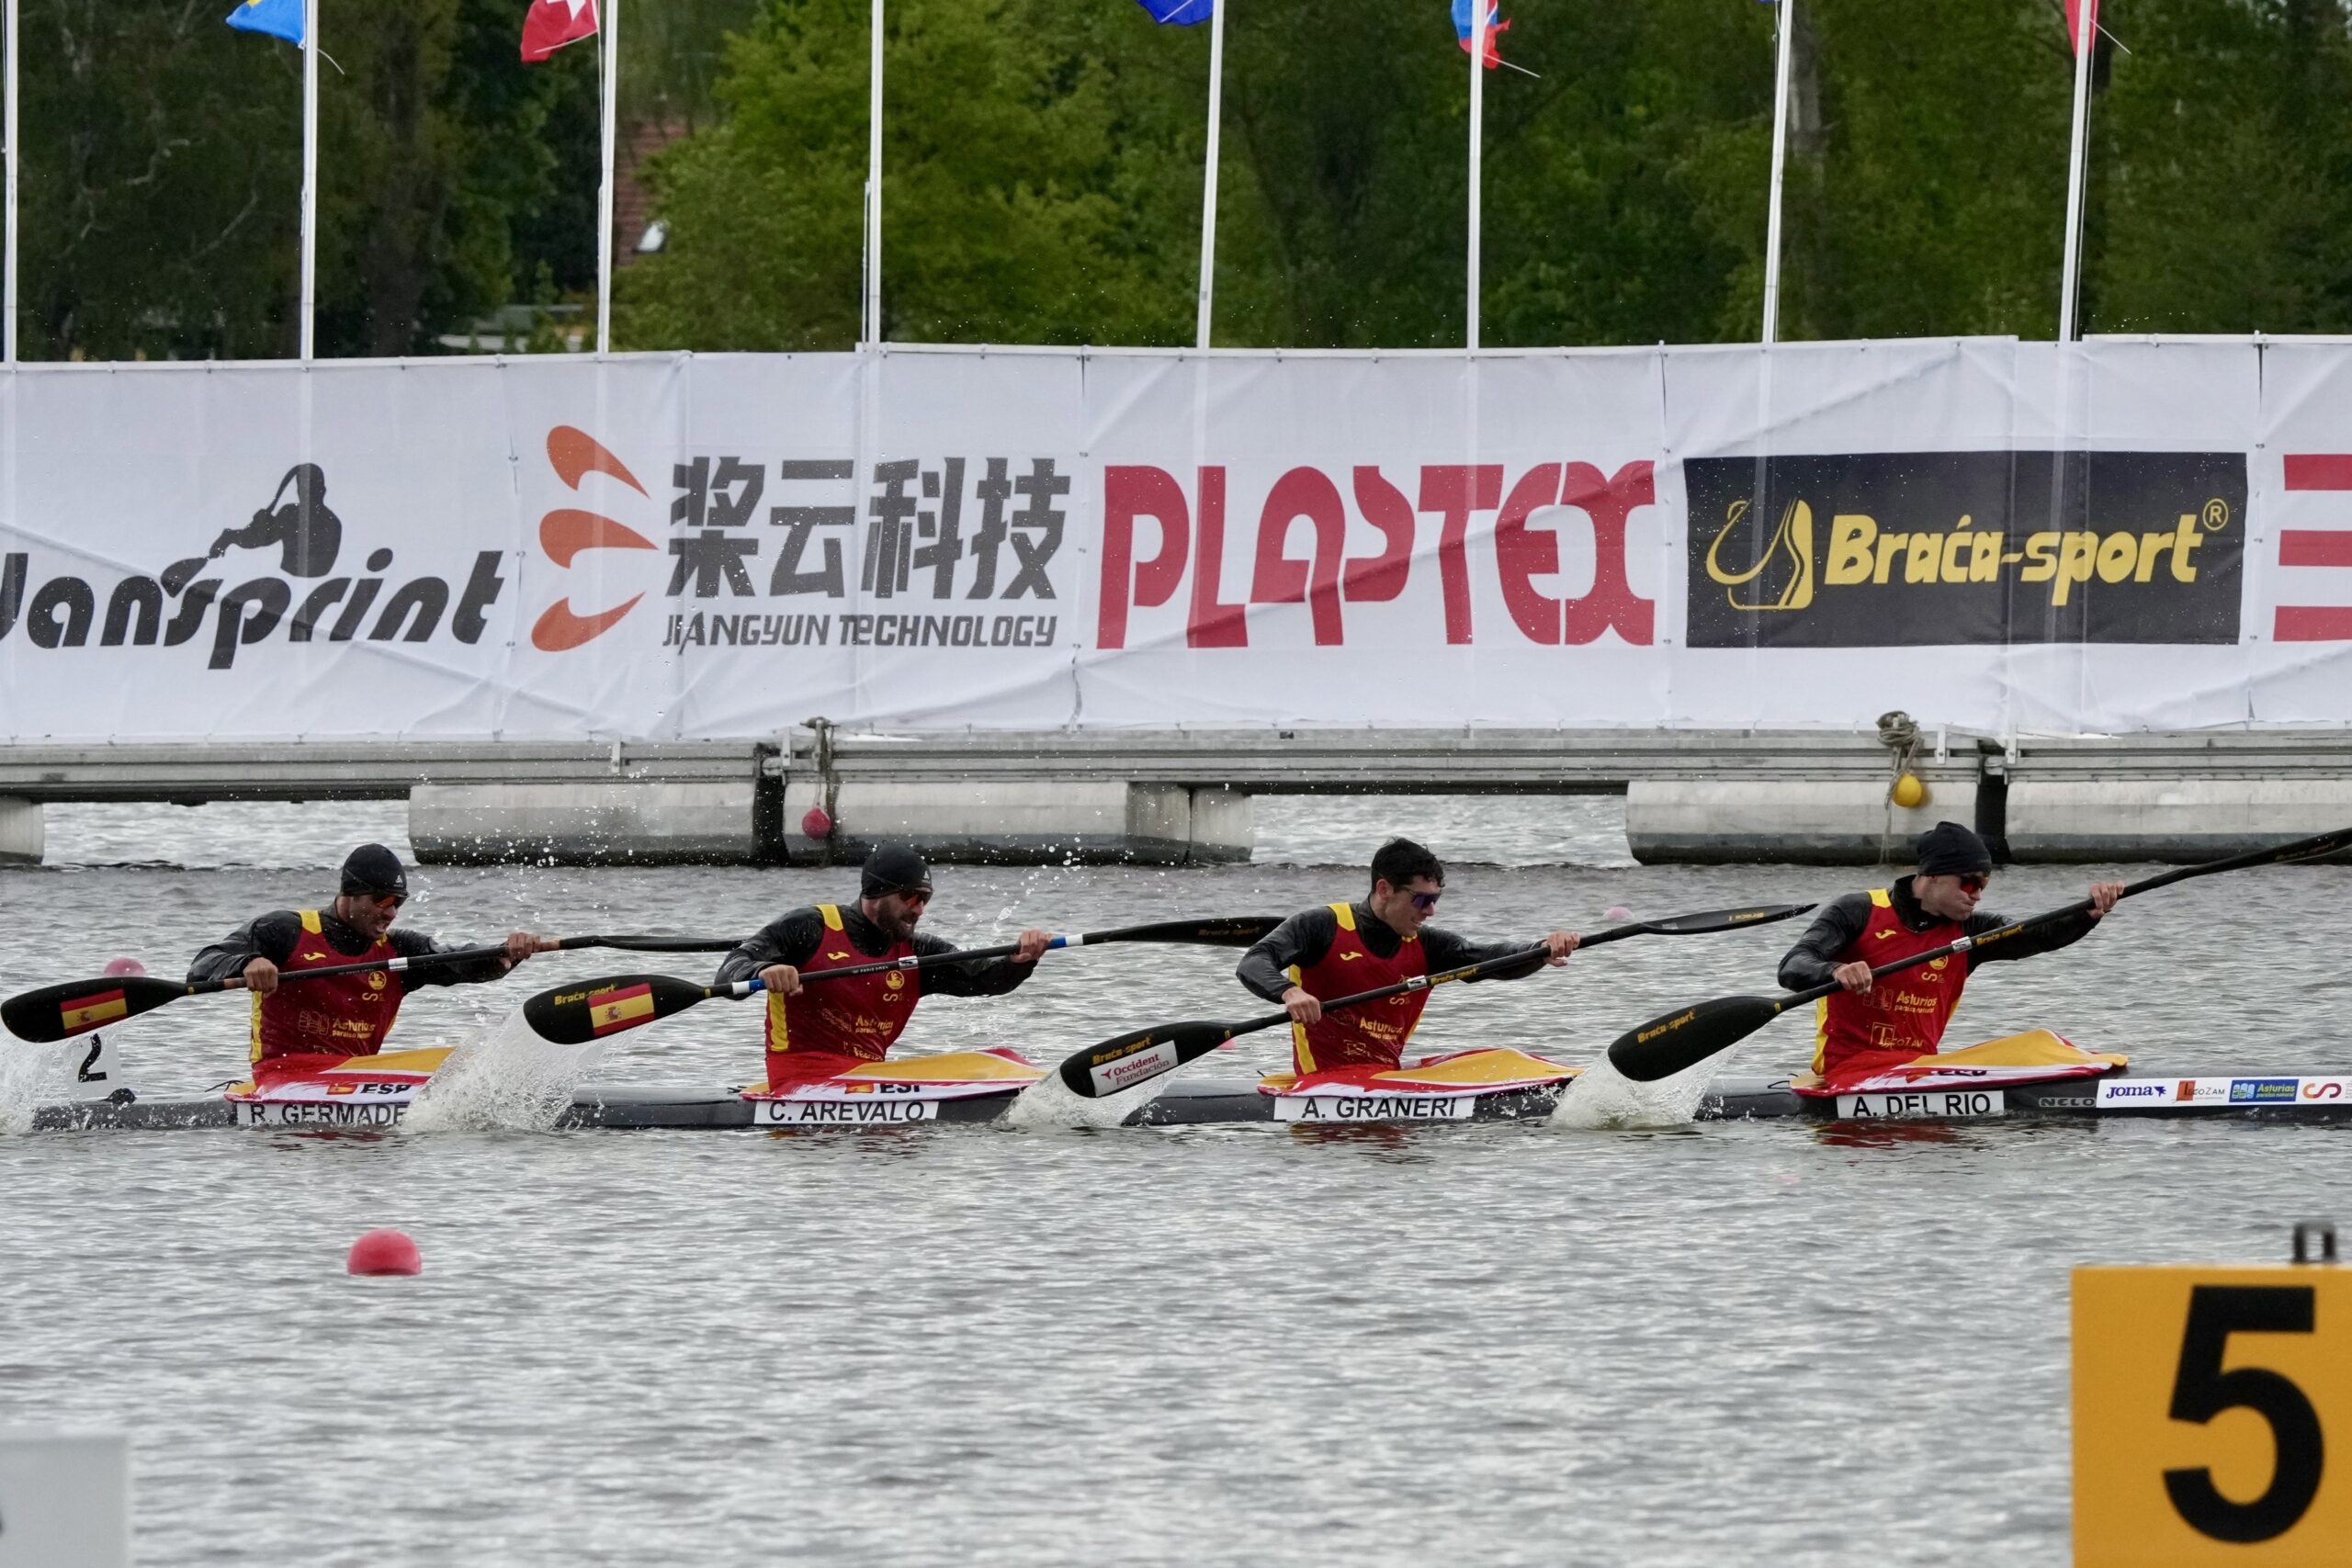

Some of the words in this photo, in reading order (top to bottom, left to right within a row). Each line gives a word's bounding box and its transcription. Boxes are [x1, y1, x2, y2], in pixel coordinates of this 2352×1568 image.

[666, 457, 1070, 600] 桨云科技
[1097, 460, 1655, 649] PLASTEX
[662, 612, 831, 656] JIANGYUN
[1895, 990, 1938, 1007] Asturias
[78, 1032, 107, 1083] 2
[1113, 1054, 1160, 1077] Occident
[1115, 1060, 1170, 1085] Fundación
[360, 1083, 413, 1095] ESP
[2256, 1083, 2296, 1093] Asturias
[769, 1102, 792, 1122] C.
[800, 1101, 924, 1122] AREVALO
[1301, 1097, 1326, 1119] A.
[1336, 1097, 1456, 1118] GRANERI
[1853, 1096, 1877, 1117] A.
[1886, 1095, 1938, 1116] DEL
[1945, 1093, 1991, 1115] RIO
[2040, 1098, 2096, 1107] NELO
[2162, 1284, 2325, 1544] 5
